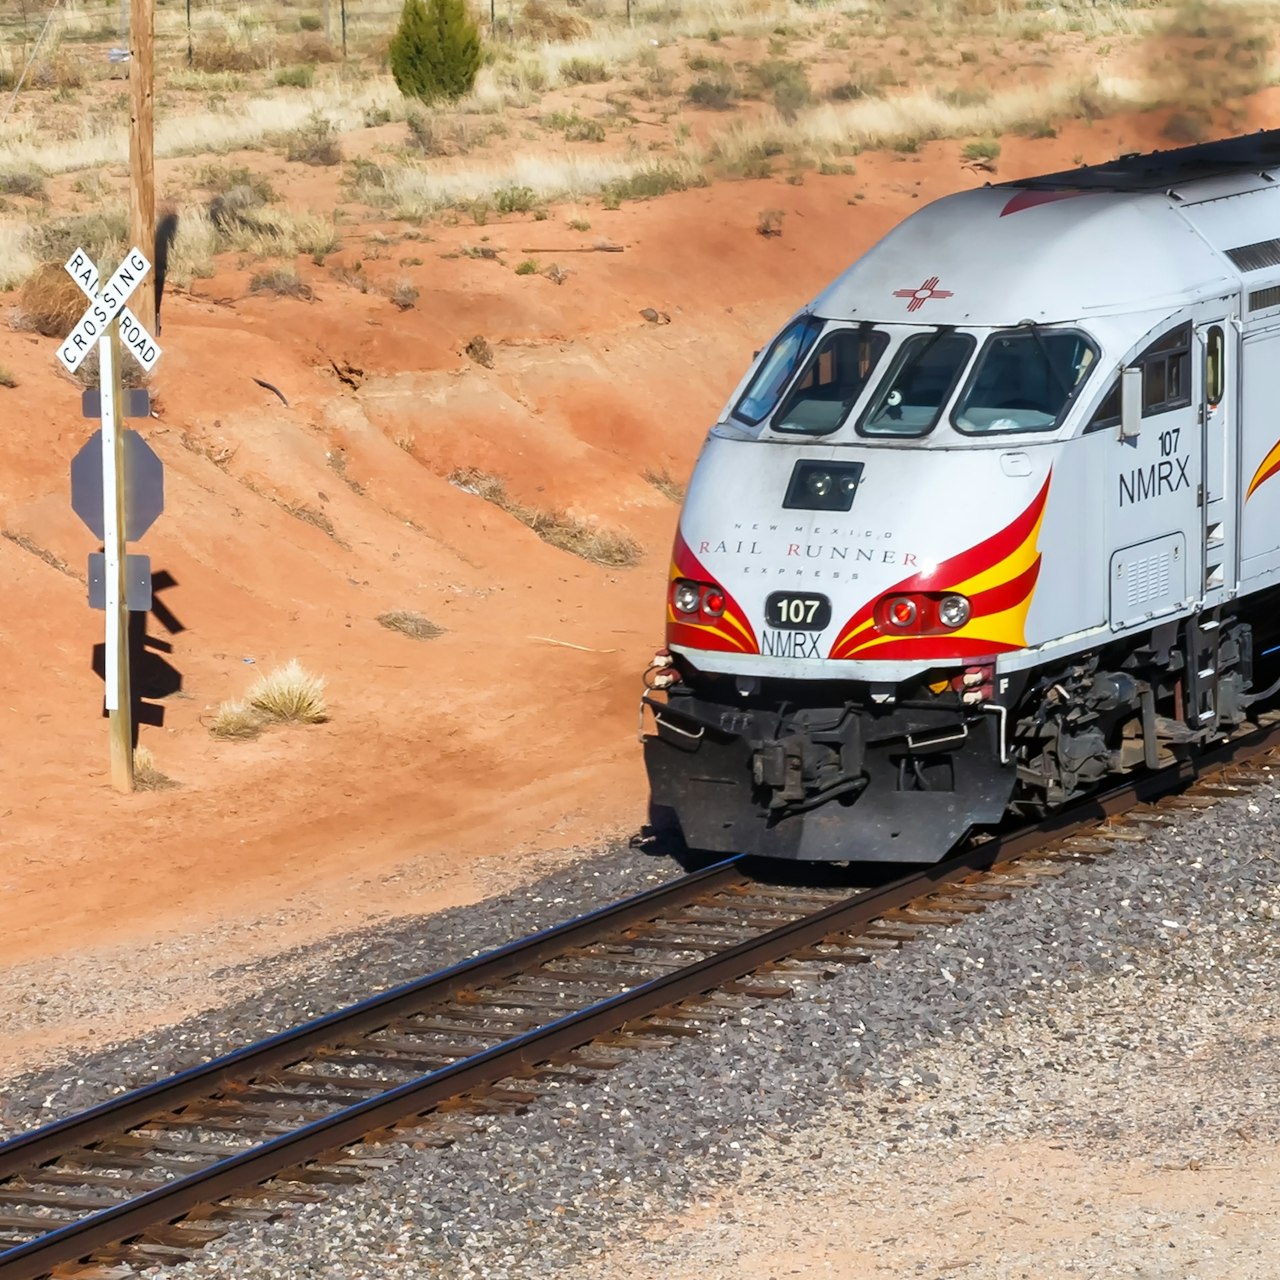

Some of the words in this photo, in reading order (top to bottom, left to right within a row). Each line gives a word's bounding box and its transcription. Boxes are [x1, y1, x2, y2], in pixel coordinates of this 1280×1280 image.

[63, 255, 144, 363] CROSSING
[119, 316, 155, 363] ROAD
[1159, 427, 1180, 457] 107
[1120, 454, 1190, 507] NMRX
[735, 523, 778, 531] NEW
[795, 526, 892, 539] MEXICO
[699, 540, 762, 555] RAIL
[787, 543, 918, 567] RUNNER
[744, 567, 859, 580] EXPRESS
[777, 599, 820, 624] 107
[761, 630, 822, 658] NMRX
[1000, 678, 1009, 694] F
